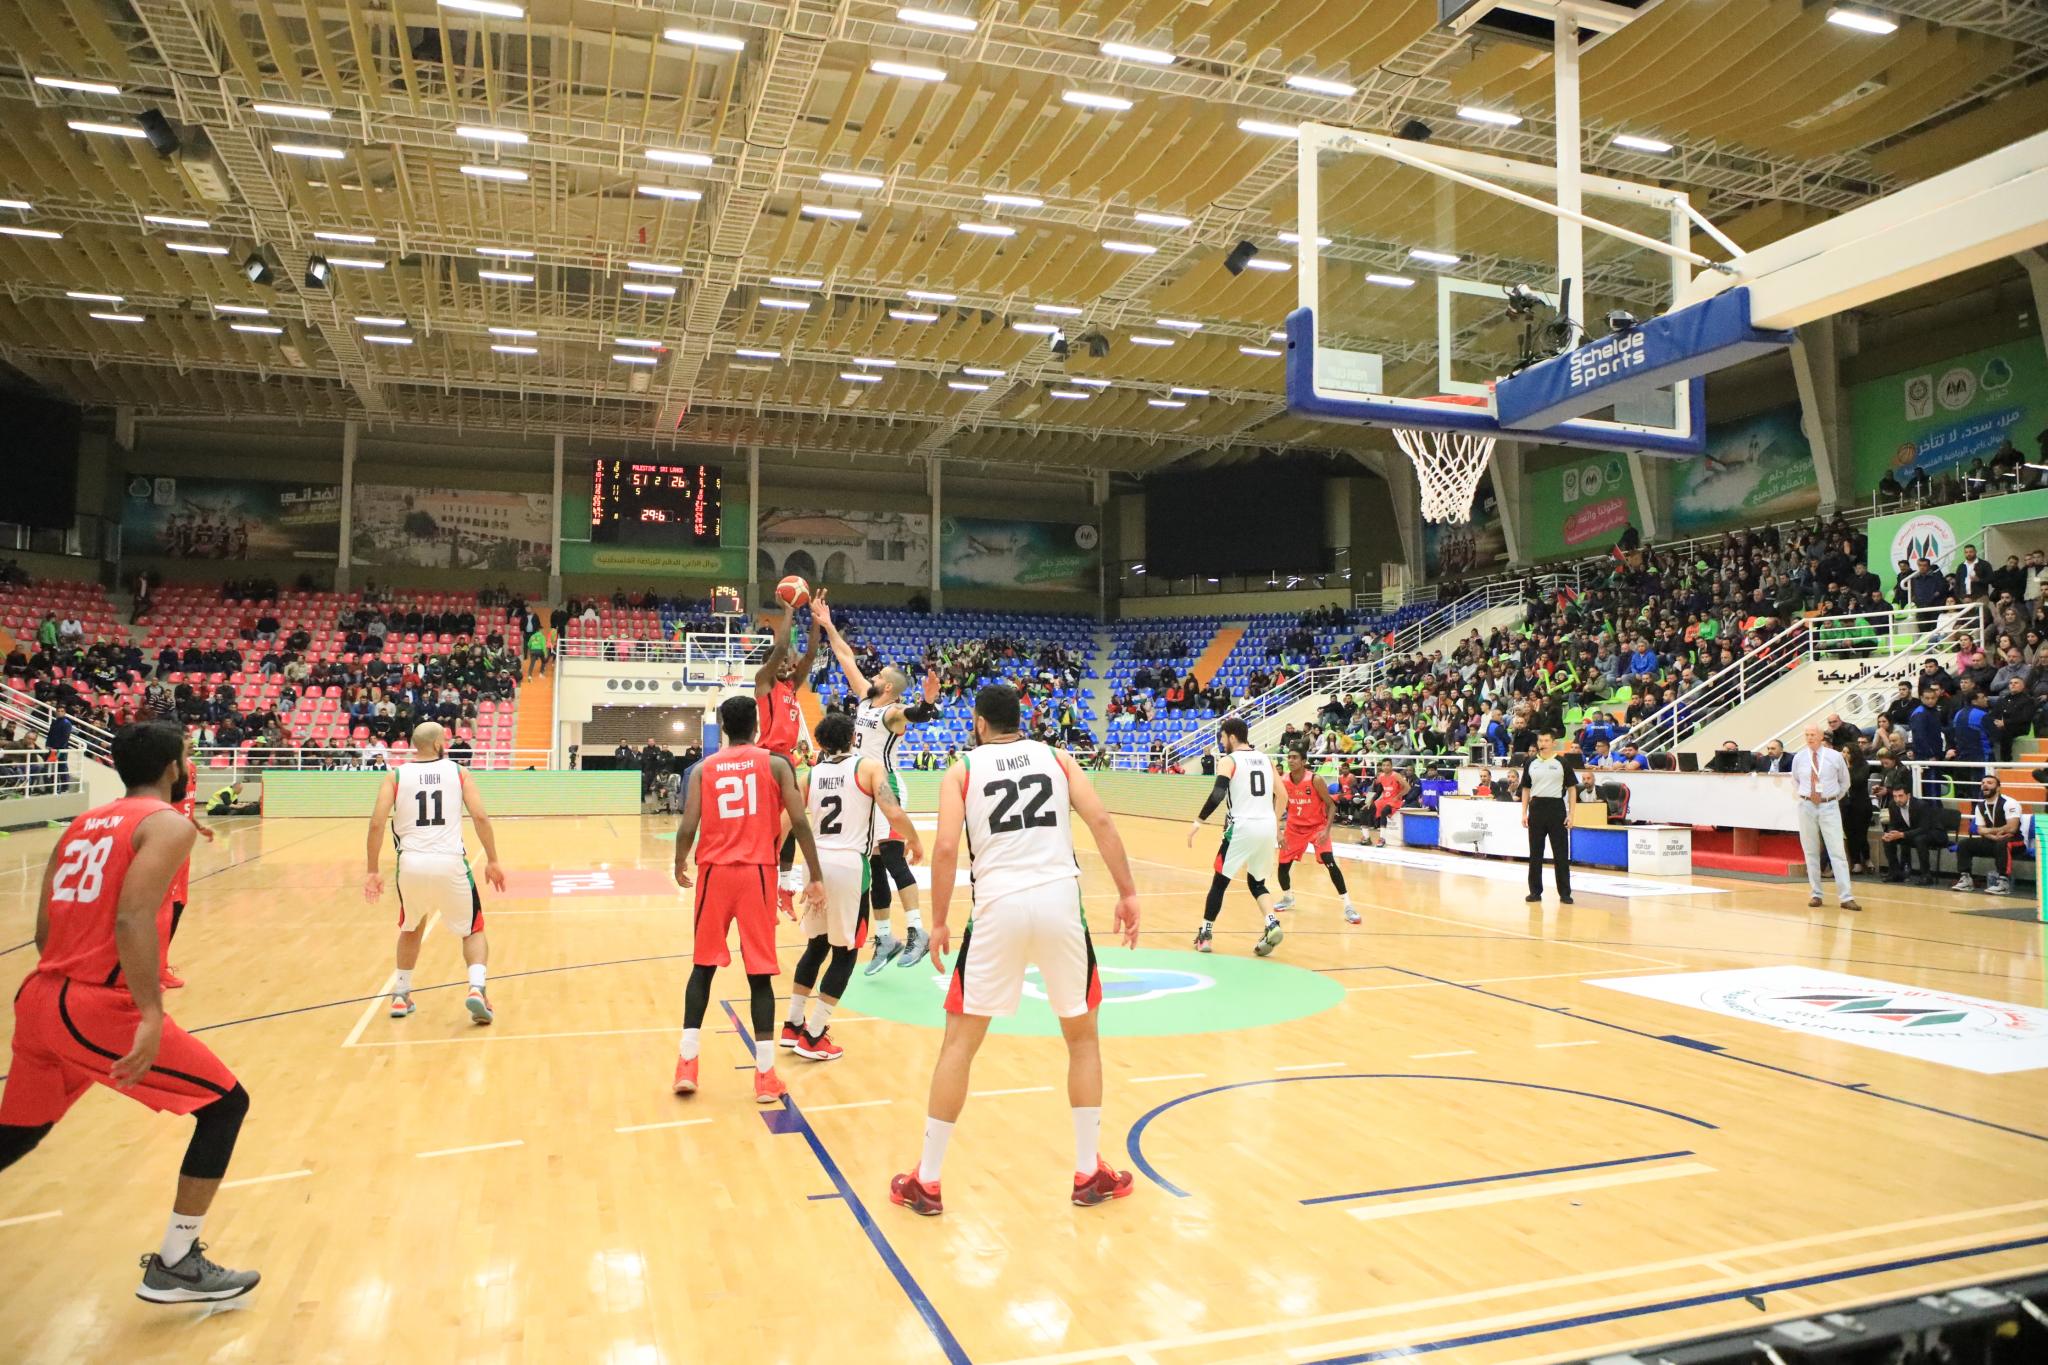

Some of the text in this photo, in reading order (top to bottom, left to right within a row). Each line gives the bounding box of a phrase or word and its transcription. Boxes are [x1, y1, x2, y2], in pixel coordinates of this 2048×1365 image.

[1570, 332, 1644, 371] Schelde
[1570, 350, 1644, 387] Sports
[716, 760, 754, 772] NIMESH
[1250, 770, 1266, 797] 0
[415, 790, 445, 826] 11
[715, 773, 757, 819] 21
[820, 795, 842, 835] 2
[983, 773, 1057, 835] 22
[51, 836, 113, 903] 28
